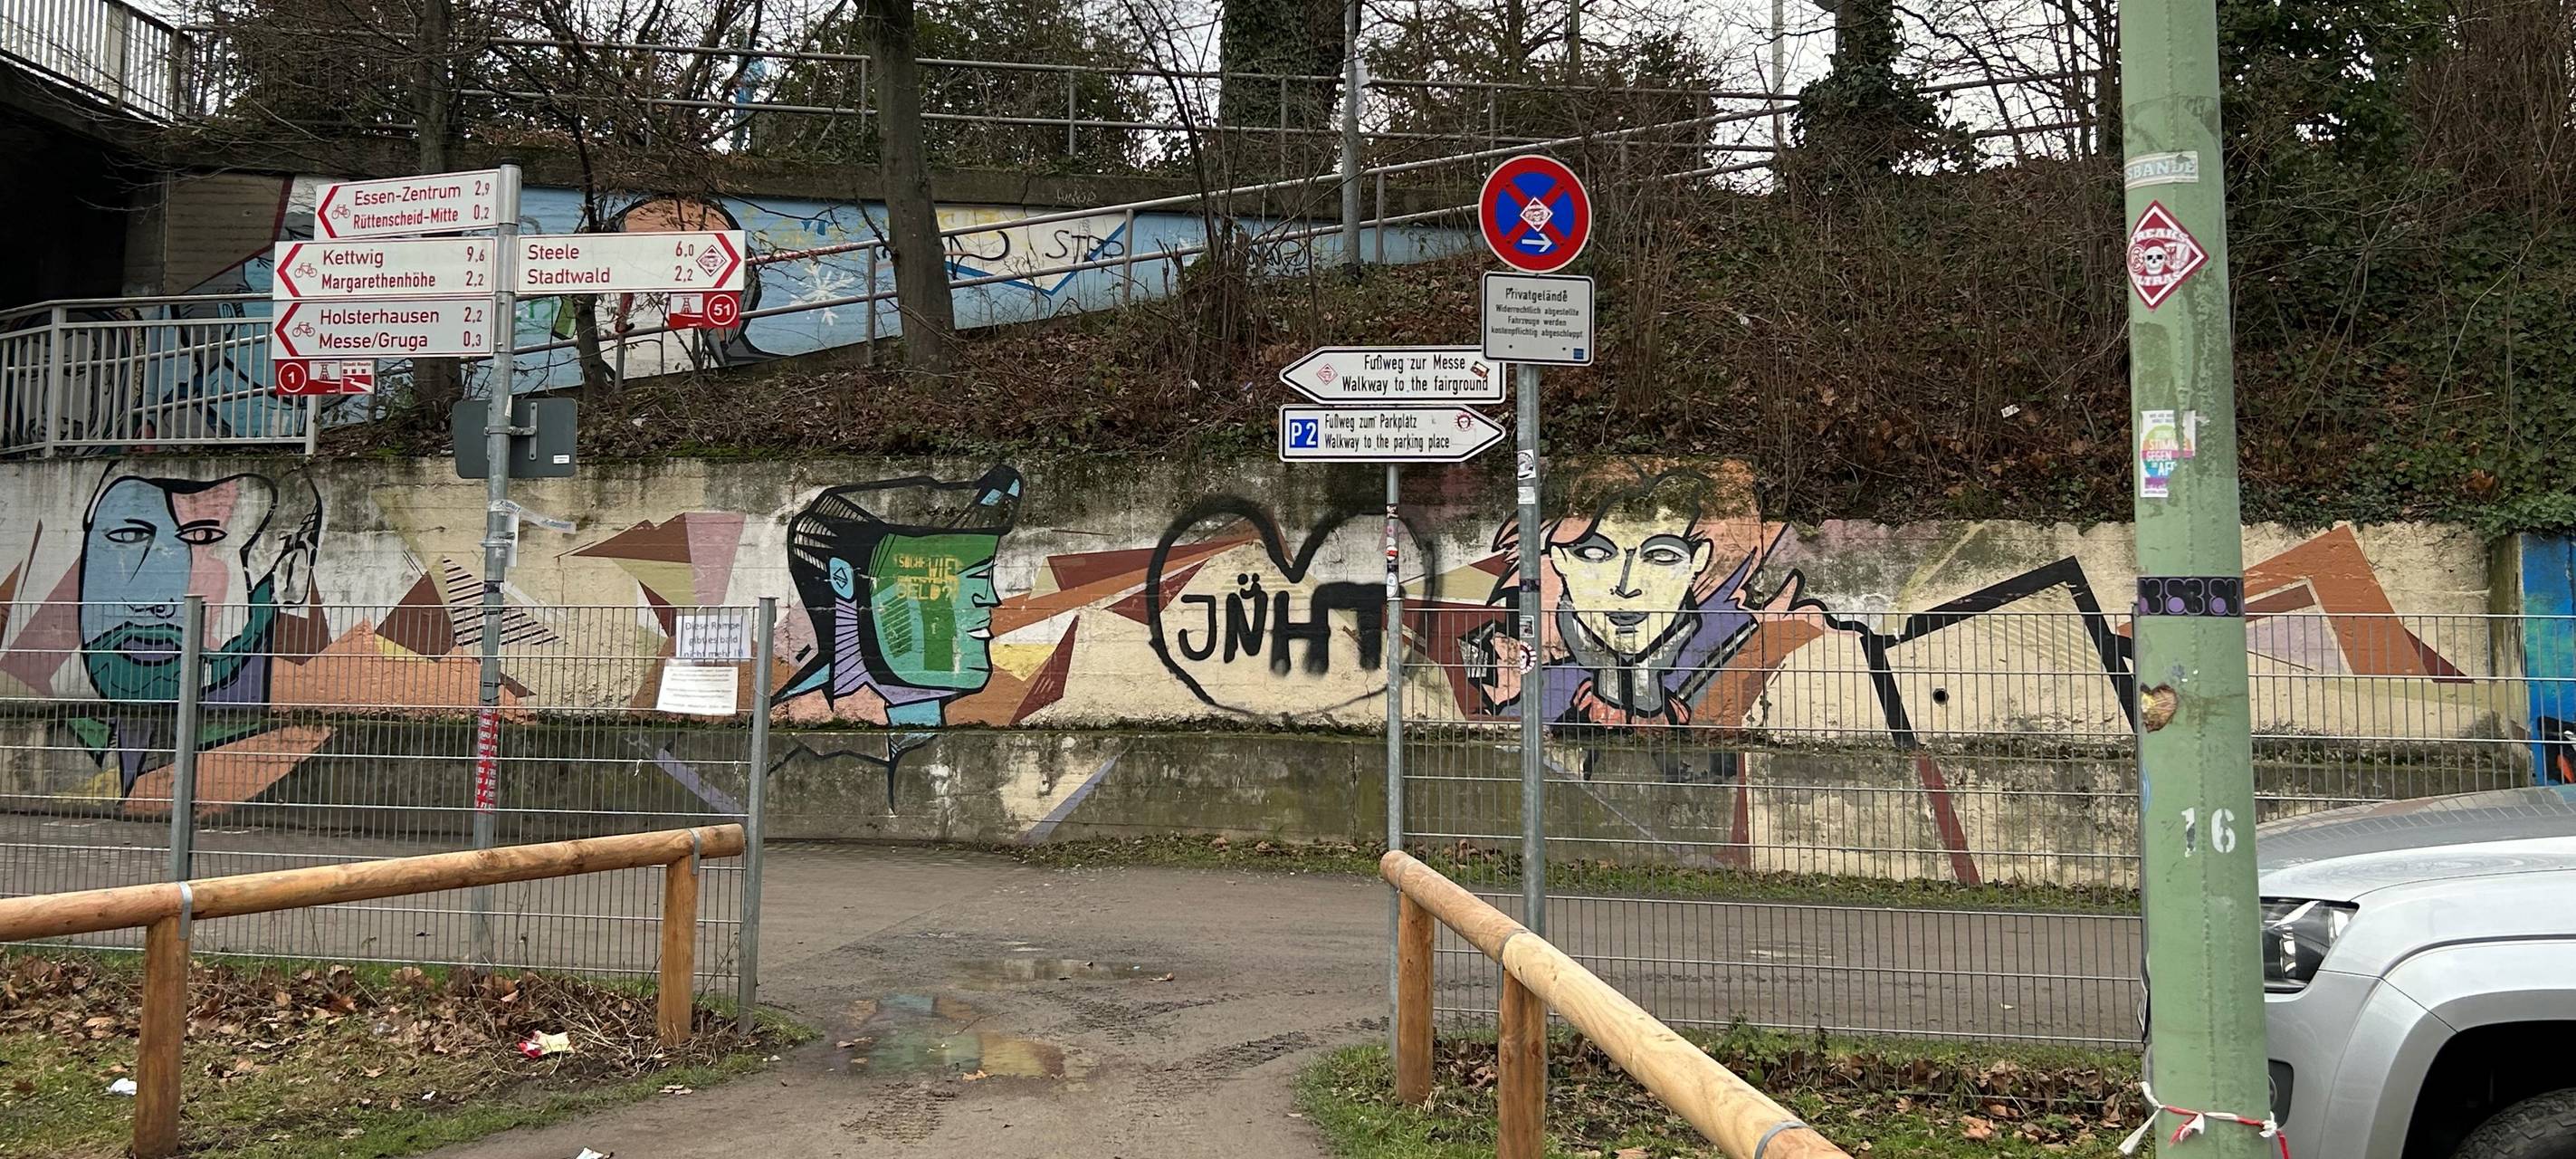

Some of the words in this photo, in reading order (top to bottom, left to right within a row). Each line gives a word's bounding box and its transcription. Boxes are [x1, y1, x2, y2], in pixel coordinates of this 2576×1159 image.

[355, 185, 461, 206] Essen-Zentrum
[475, 180, 490, 196] 2,9
[353, 209, 459, 230] Rüttenscheid-Mitte
[473, 205, 490, 220] 0,2
[323, 249, 384, 268] Kettwig
[466, 245, 485, 263] 9,6
[528, 244, 579, 261] Steele
[675, 240, 694, 258] 6,0
[321, 271, 436, 292] Margarethenhöhe
[466, 271, 484, 287] 2,2
[527, 267, 610, 285] Stadtwald
[674, 265, 693, 282] 2,2
[1505, 288, 1568, 303] Privatgelände
[320, 308, 440, 325] Holsterhausen
[463, 306, 482, 323] 2,2
[713, 303, 730, 316] 51
[1495, 304, 1541, 314] Widerrechtlich
[1544, 308, 1579, 317] abgestellte
[1508, 316, 1540, 327] Fahrzeuge
[1543, 318, 1567, 326] werden
[319, 331, 428, 351] Messe/Gruga
[463, 331, 482, 348] 0,3
[1491, 327, 1538, 338] kostenpflichtig
[1541, 329, 1583, 340] abgeschleppt
[1364, 354, 1404, 373] Fußweg
[1410, 358, 1426, 369] zur
[1433, 355, 1465, 369] Messe
[288, 371, 295, 384] 1
[1341, 376, 1388, 395] Walkway
[1394, 377, 1405, 391] to
[1411, 377, 1427, 391] the
[1434, 376, 1488, 395] fairground
[1324, 414, 1355, 432] Fußweg
[1360, 417, 1376, 428] zum
[1379, 414, 1417, 432] Parkplatz
[1324, 434, 1359, 452] Walkway
[1363, 435, 1371, 448] to
[1376, 435, 1389, 448] the
[1394, 434, 1424, 452] parking
[1428, 434, 1449, 453] place
[685, 622, 709, 630] Diese
[711, 621, 740, 631] Rampe
[2180, 807, 2236, 857] 16
